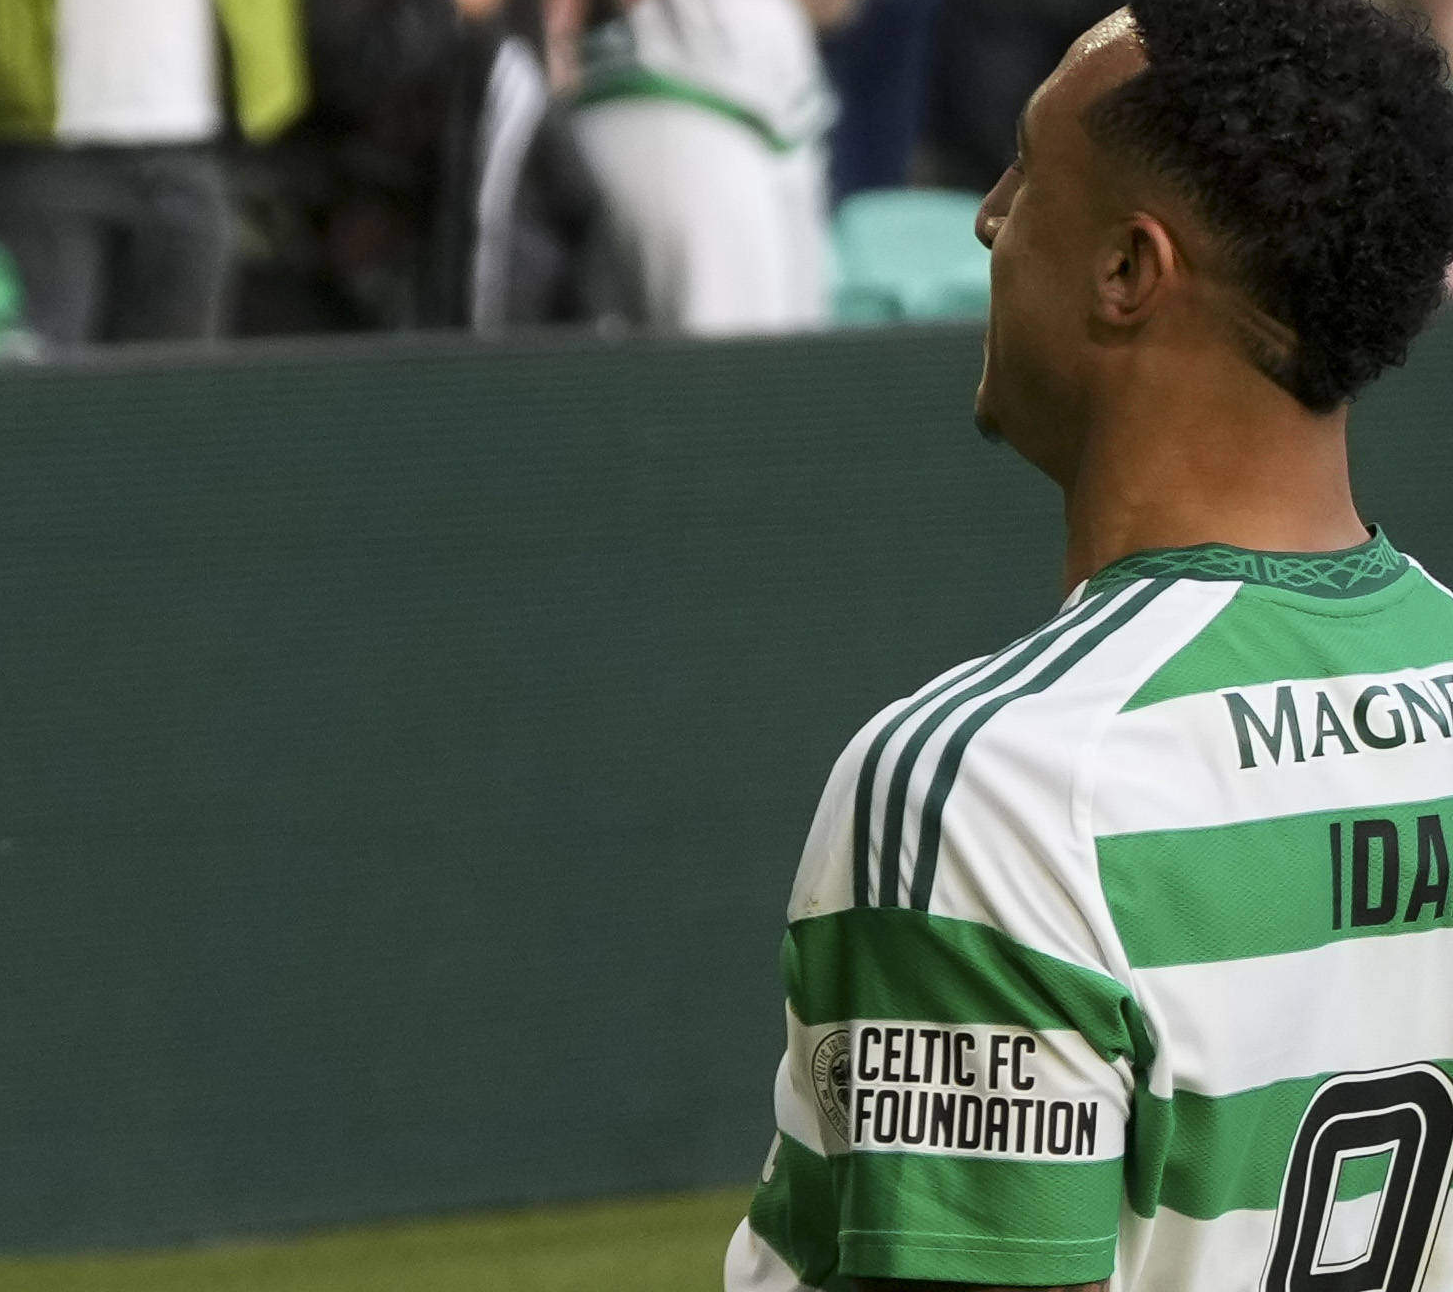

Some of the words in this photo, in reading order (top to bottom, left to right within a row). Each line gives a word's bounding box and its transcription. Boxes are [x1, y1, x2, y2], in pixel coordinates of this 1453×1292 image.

[858, 1026, 976, 1087] CELTIC
[989, 1034, 1036, 1091] FC
[854, 1088, 1098, 1156] FOUNDATION
